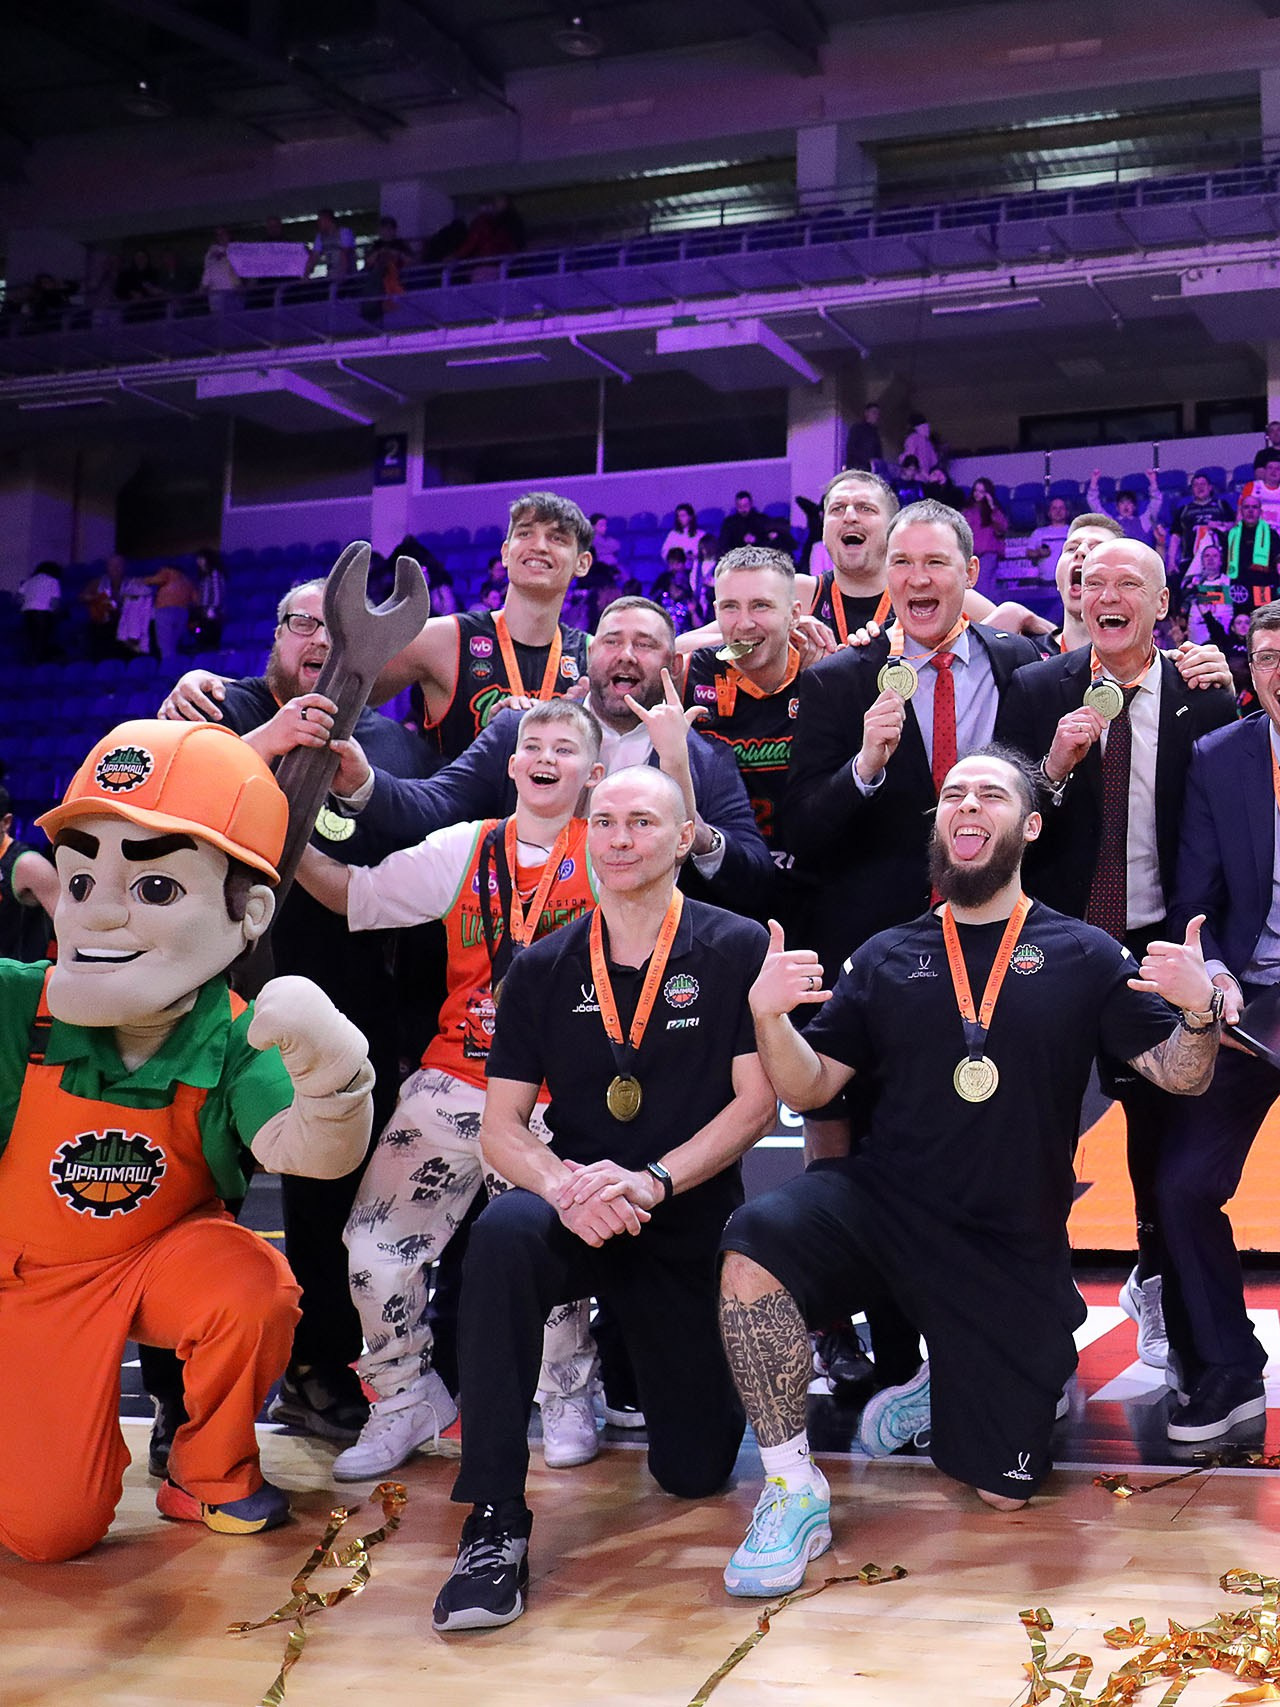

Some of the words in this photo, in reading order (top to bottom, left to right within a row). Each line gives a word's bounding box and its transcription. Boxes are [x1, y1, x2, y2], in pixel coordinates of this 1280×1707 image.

[384, 441, 400, 466] 2
[472, 641, 491, 652] wb
[102, 763, 145, 776] УРАЛМАШ
[547, 898, 586, 908] EGION
[572, 1003, 601, 1013] JÖGE
[665, 1017, 700, 1031] PARI
[63, 1162, 153, 1183] УРАЛМАШ
